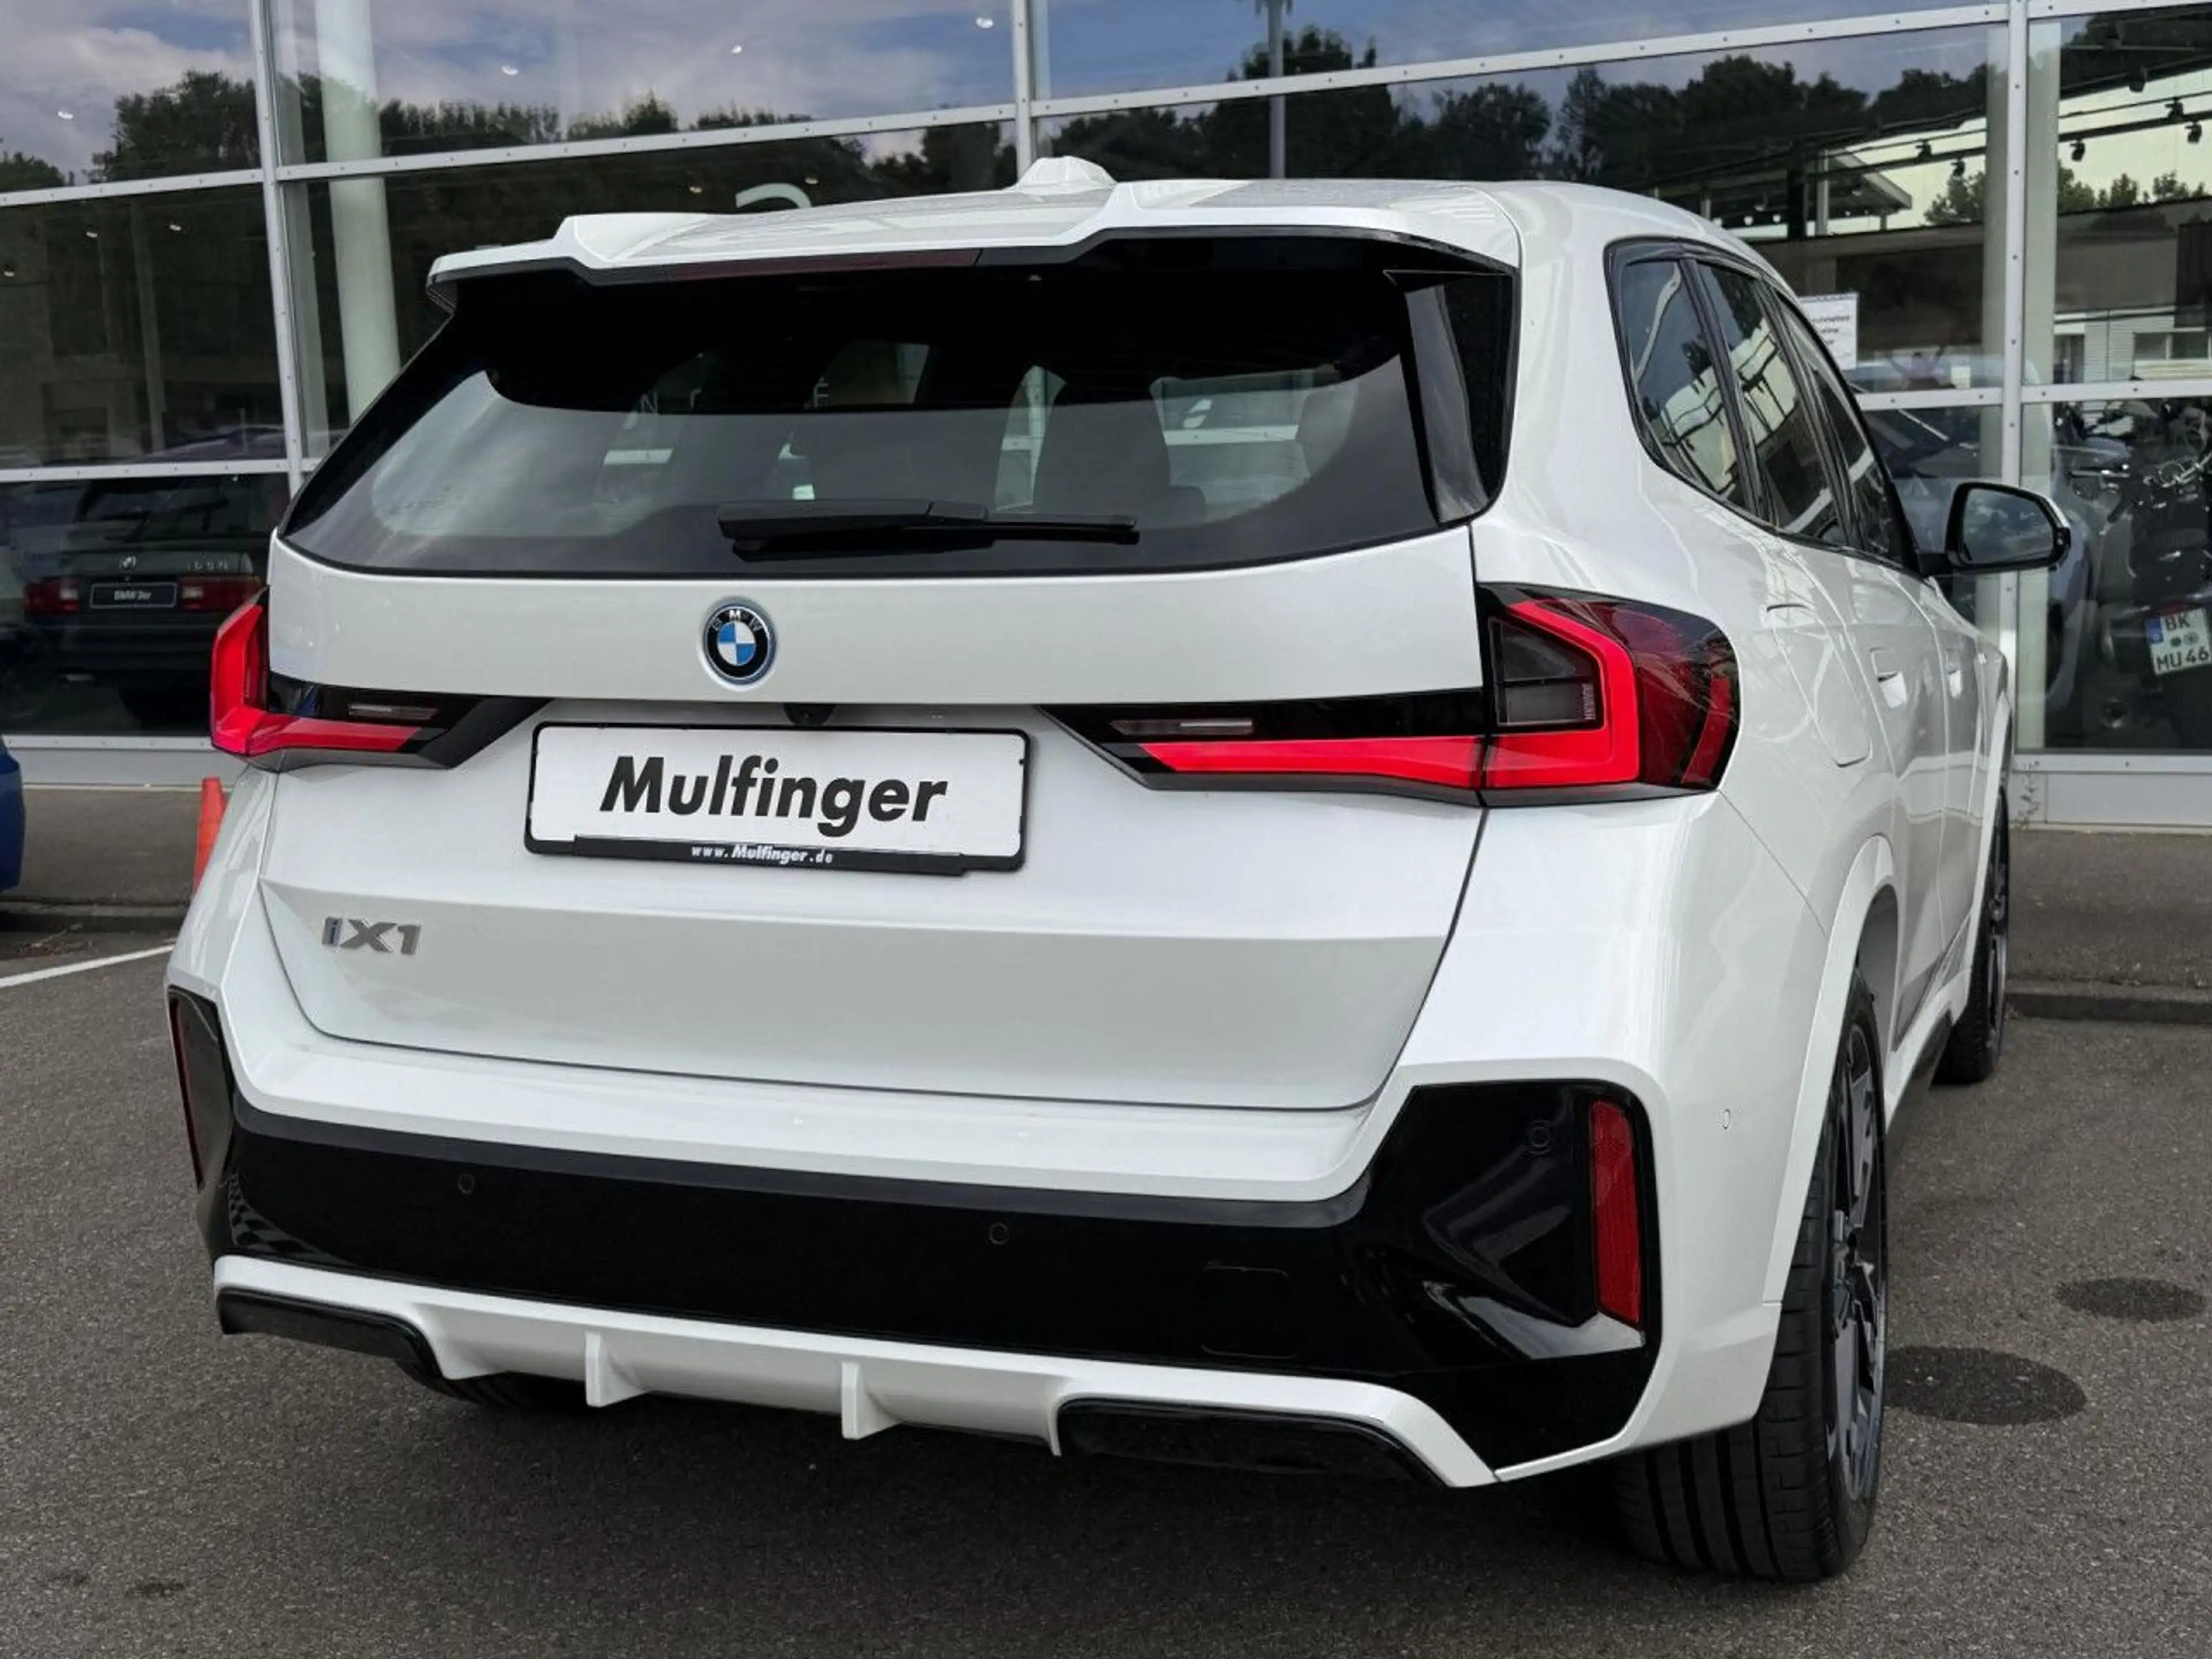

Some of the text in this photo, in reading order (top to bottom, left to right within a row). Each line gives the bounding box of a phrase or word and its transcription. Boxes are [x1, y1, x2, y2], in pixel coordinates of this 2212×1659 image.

[711, 609, 763, 631] BMW
[2165, 613, 2191, 631] BK
[2156, 646, 2210, 671] MU 46
[599, 753, 948, 838] Mulfinger
[691, 844, 834, 865] www.Mulfinger.de
